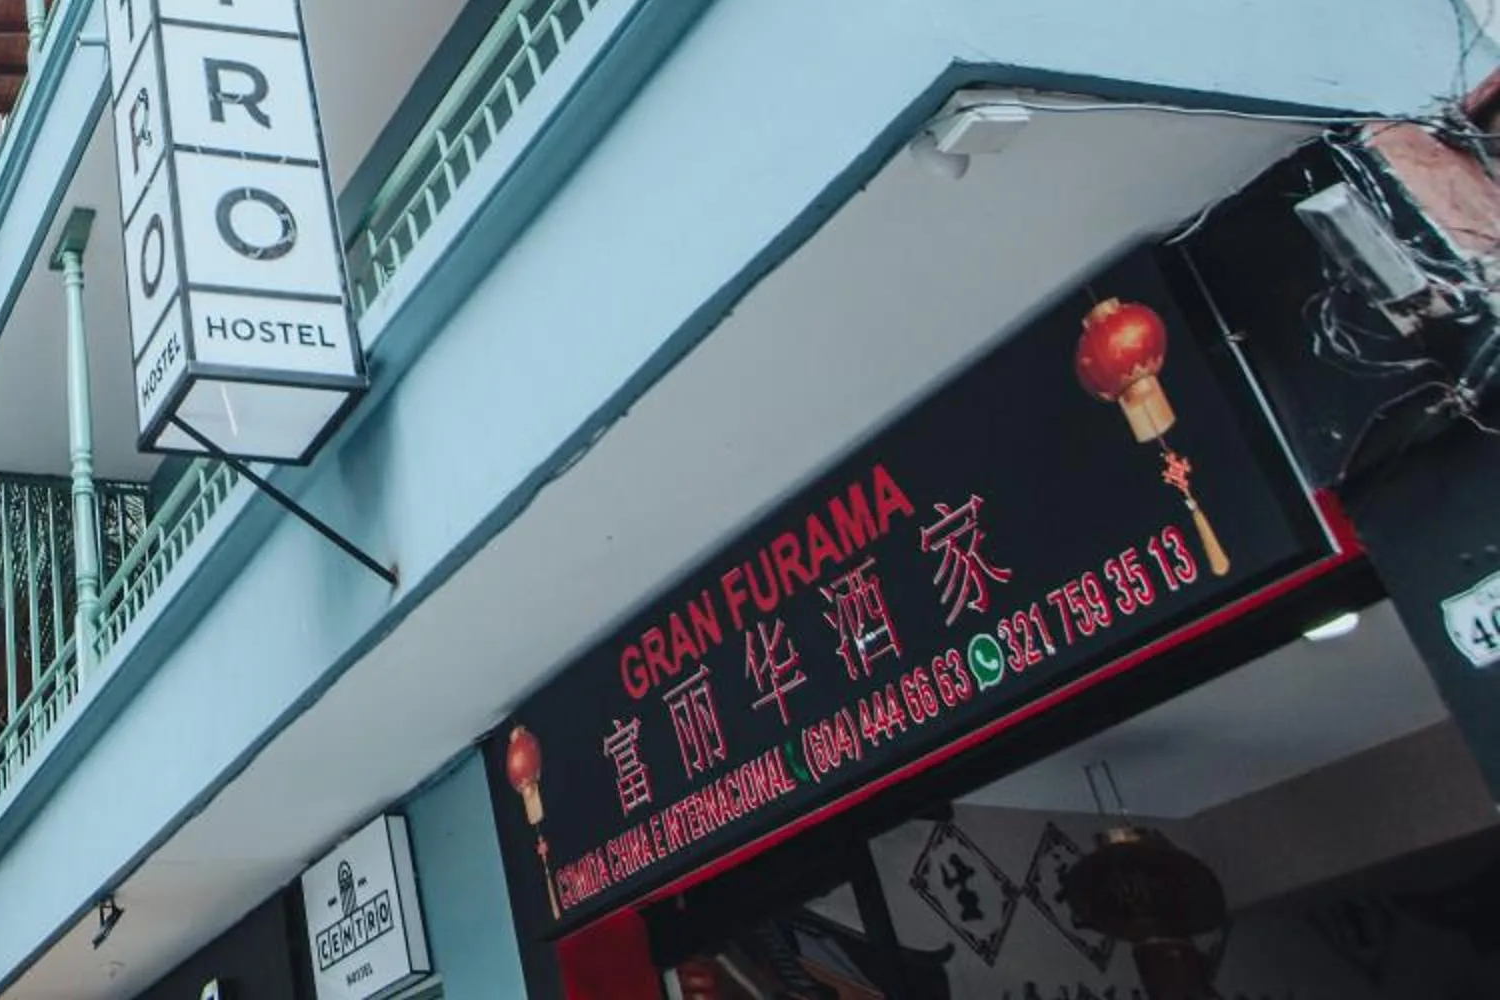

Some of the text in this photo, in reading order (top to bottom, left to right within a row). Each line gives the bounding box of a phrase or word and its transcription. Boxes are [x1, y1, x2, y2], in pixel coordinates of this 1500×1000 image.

[142, 332, 182, 408] HOSTEL
[206, 316, 336, 348] HOSTEL
[603, 494, 1013, 816] 富丽华酒家
[620, 464, 915, 699] GRAN FURAMA
[555, 524, 1199, 910] COMIDA CHINA E INTERNACIONAL (604) 444 66 63 321 759 35 13
[321, 902, 389, 959] CENTRO
